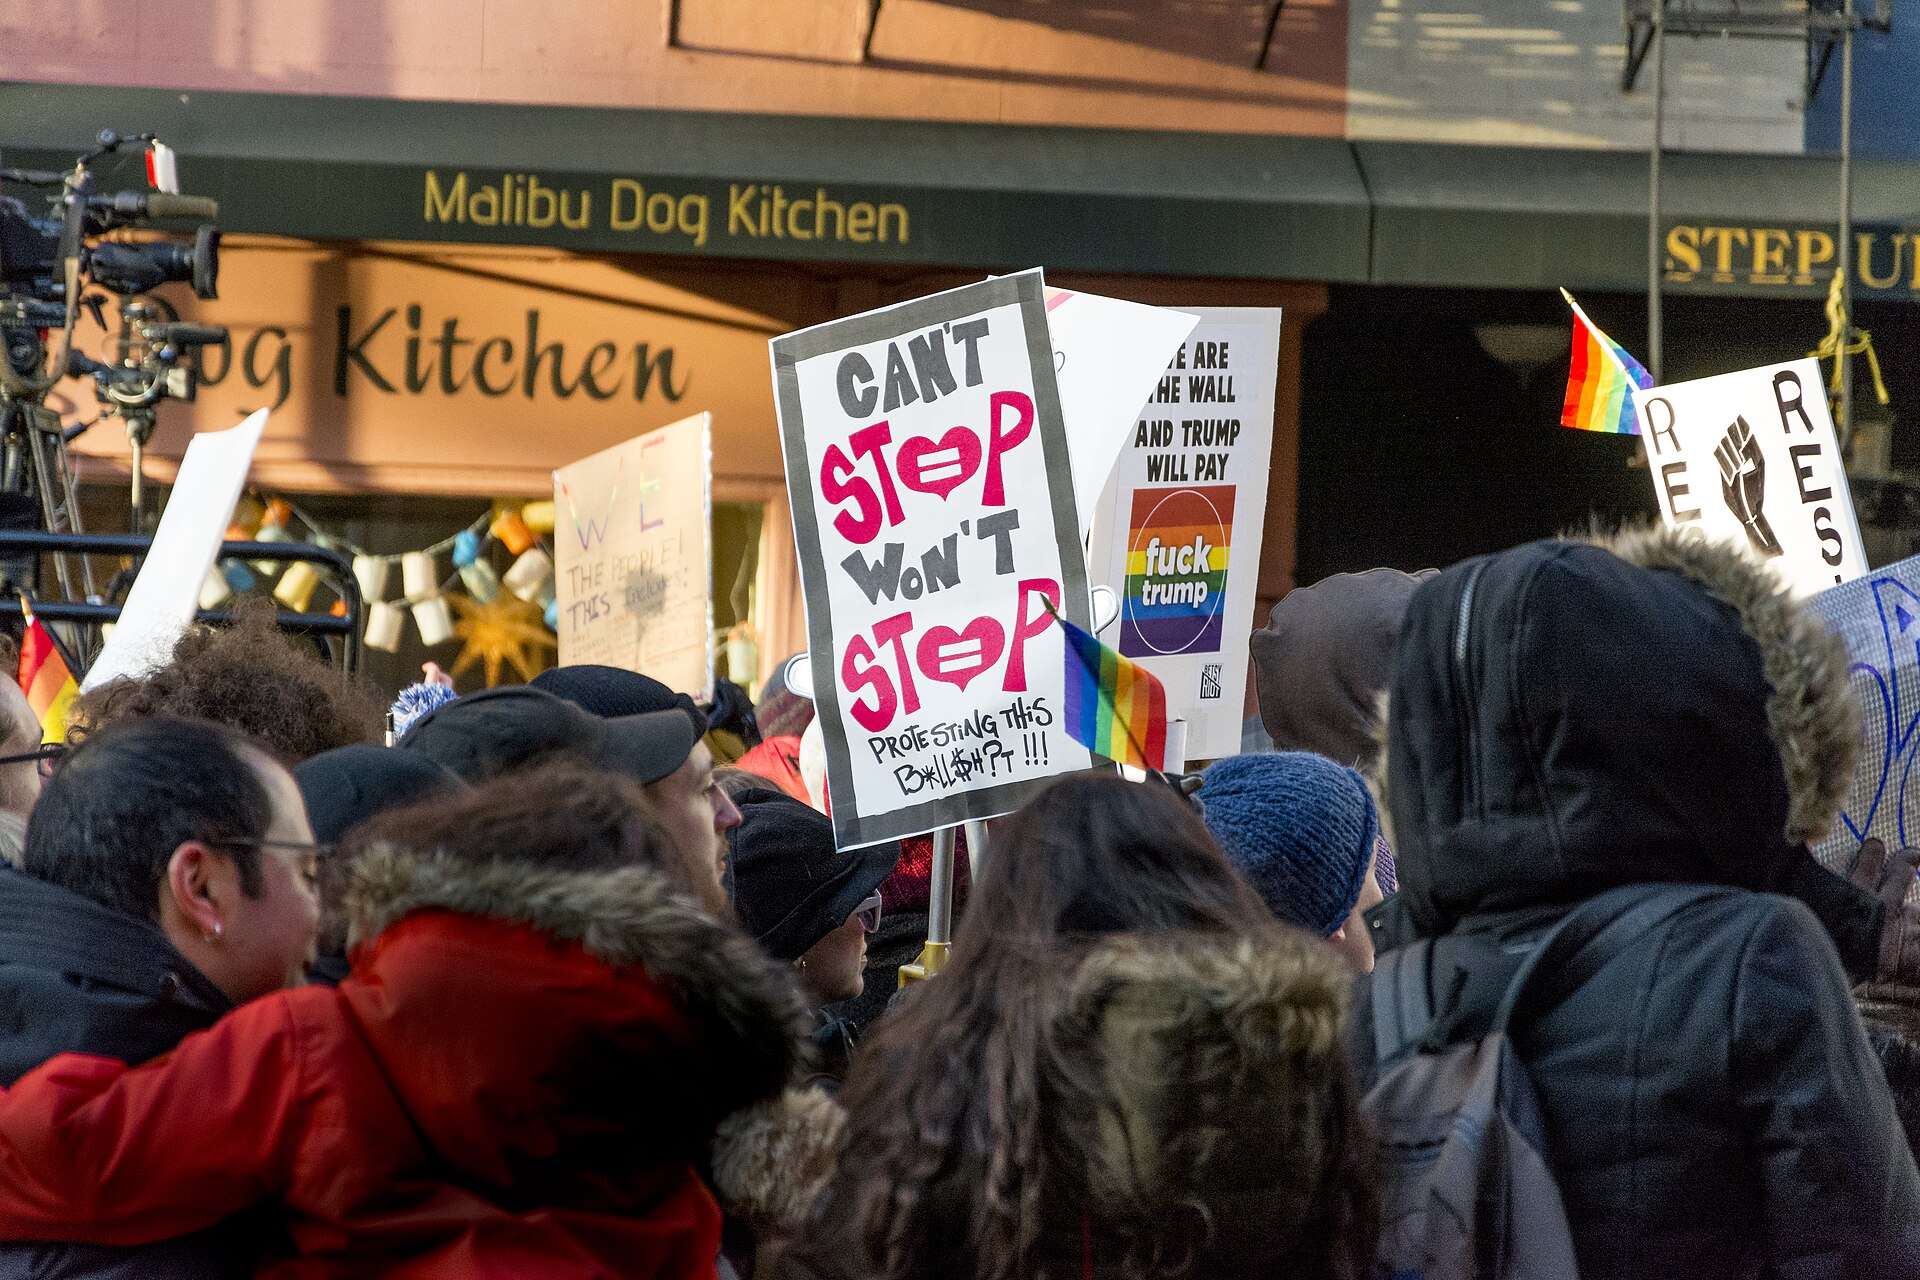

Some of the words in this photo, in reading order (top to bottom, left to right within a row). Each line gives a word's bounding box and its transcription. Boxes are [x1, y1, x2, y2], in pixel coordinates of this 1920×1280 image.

[423, 170, 592, 229] Malibu
[610, 178, 708, 248] Dog
[727, 184, 909, 244] Kitchen
[1665, 225, 1834, 286] STEP
[334, 303, 688, 402] Kitchen
[836, 317, 990, 419] CAN'T
[1167, 341, 1186, 370] E
[1193, 341, 1229, 370] ARE
[1148, 375, 1181, 404] HE
[1188, 375, 1236, 403] WALL
[1134, 419, 1174, 448] AND
[1181, 418, 1241, 447] TRUMP
[1147, 453, 1188, 482] WILL
[1194, 453, 1229, 481] PAY
[1772, 369, 1843, 584] RES
[840, 508, 1020, 606] WON'T
[1146, 535, 1213, 577] fuck
[566, 561, 603, 597] THE
[1142, 579, 1208, 609] trump
[566, 591, 611, 631] THIS
